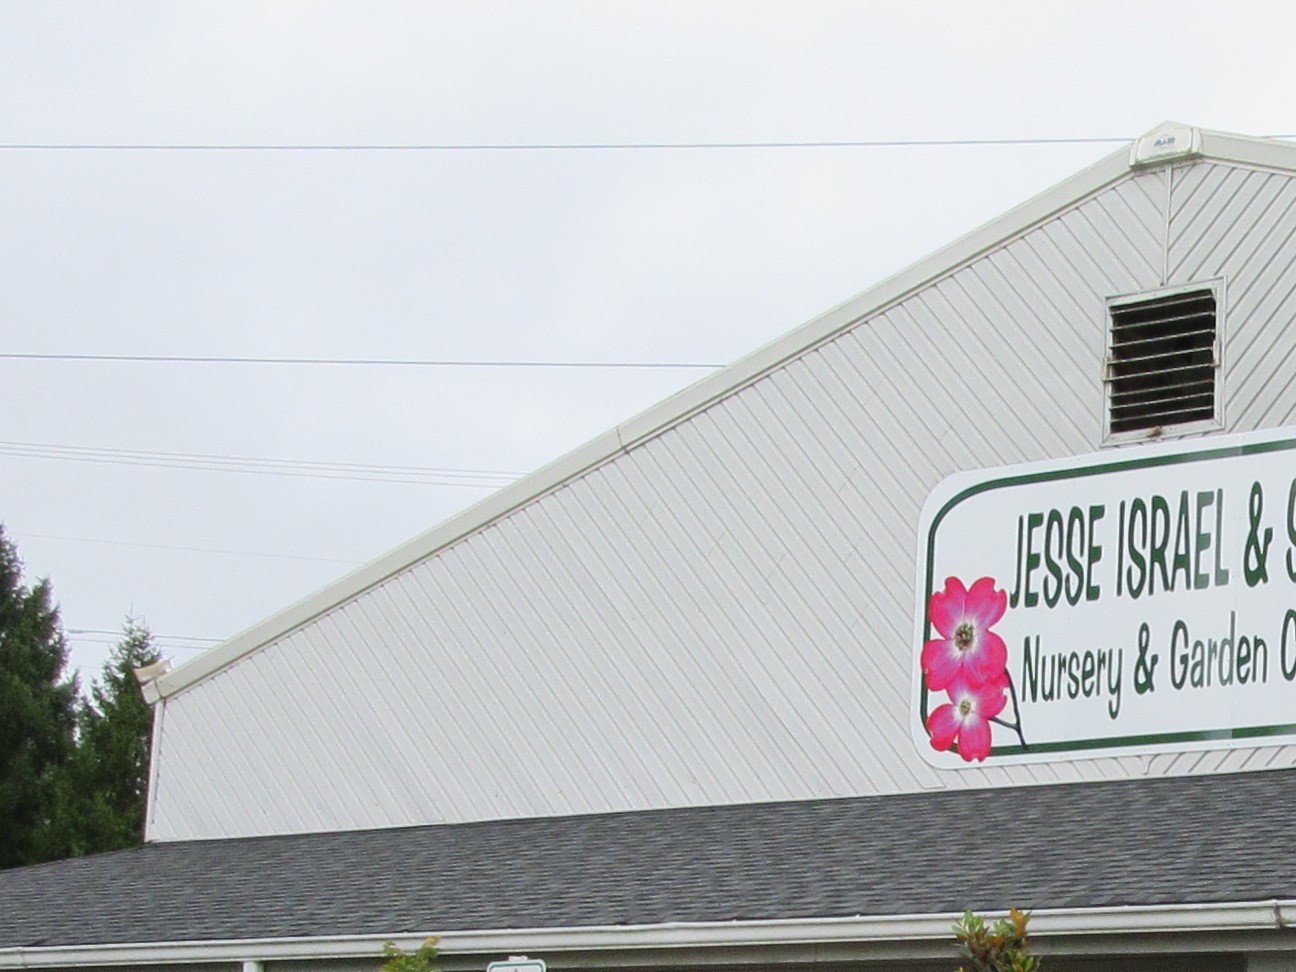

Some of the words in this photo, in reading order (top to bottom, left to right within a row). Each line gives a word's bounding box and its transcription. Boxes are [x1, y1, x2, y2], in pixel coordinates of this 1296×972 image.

[1010, 503, 1105, 609] JESSE
[1117, 488, 1229, 599] ISRAEL
[1243, 481, 1273, 588] &
[1021, 636, 1123, 720] Nursery
[1134, 622, 1158, 695] &
[1169, 610, 1267, 690] Garden
